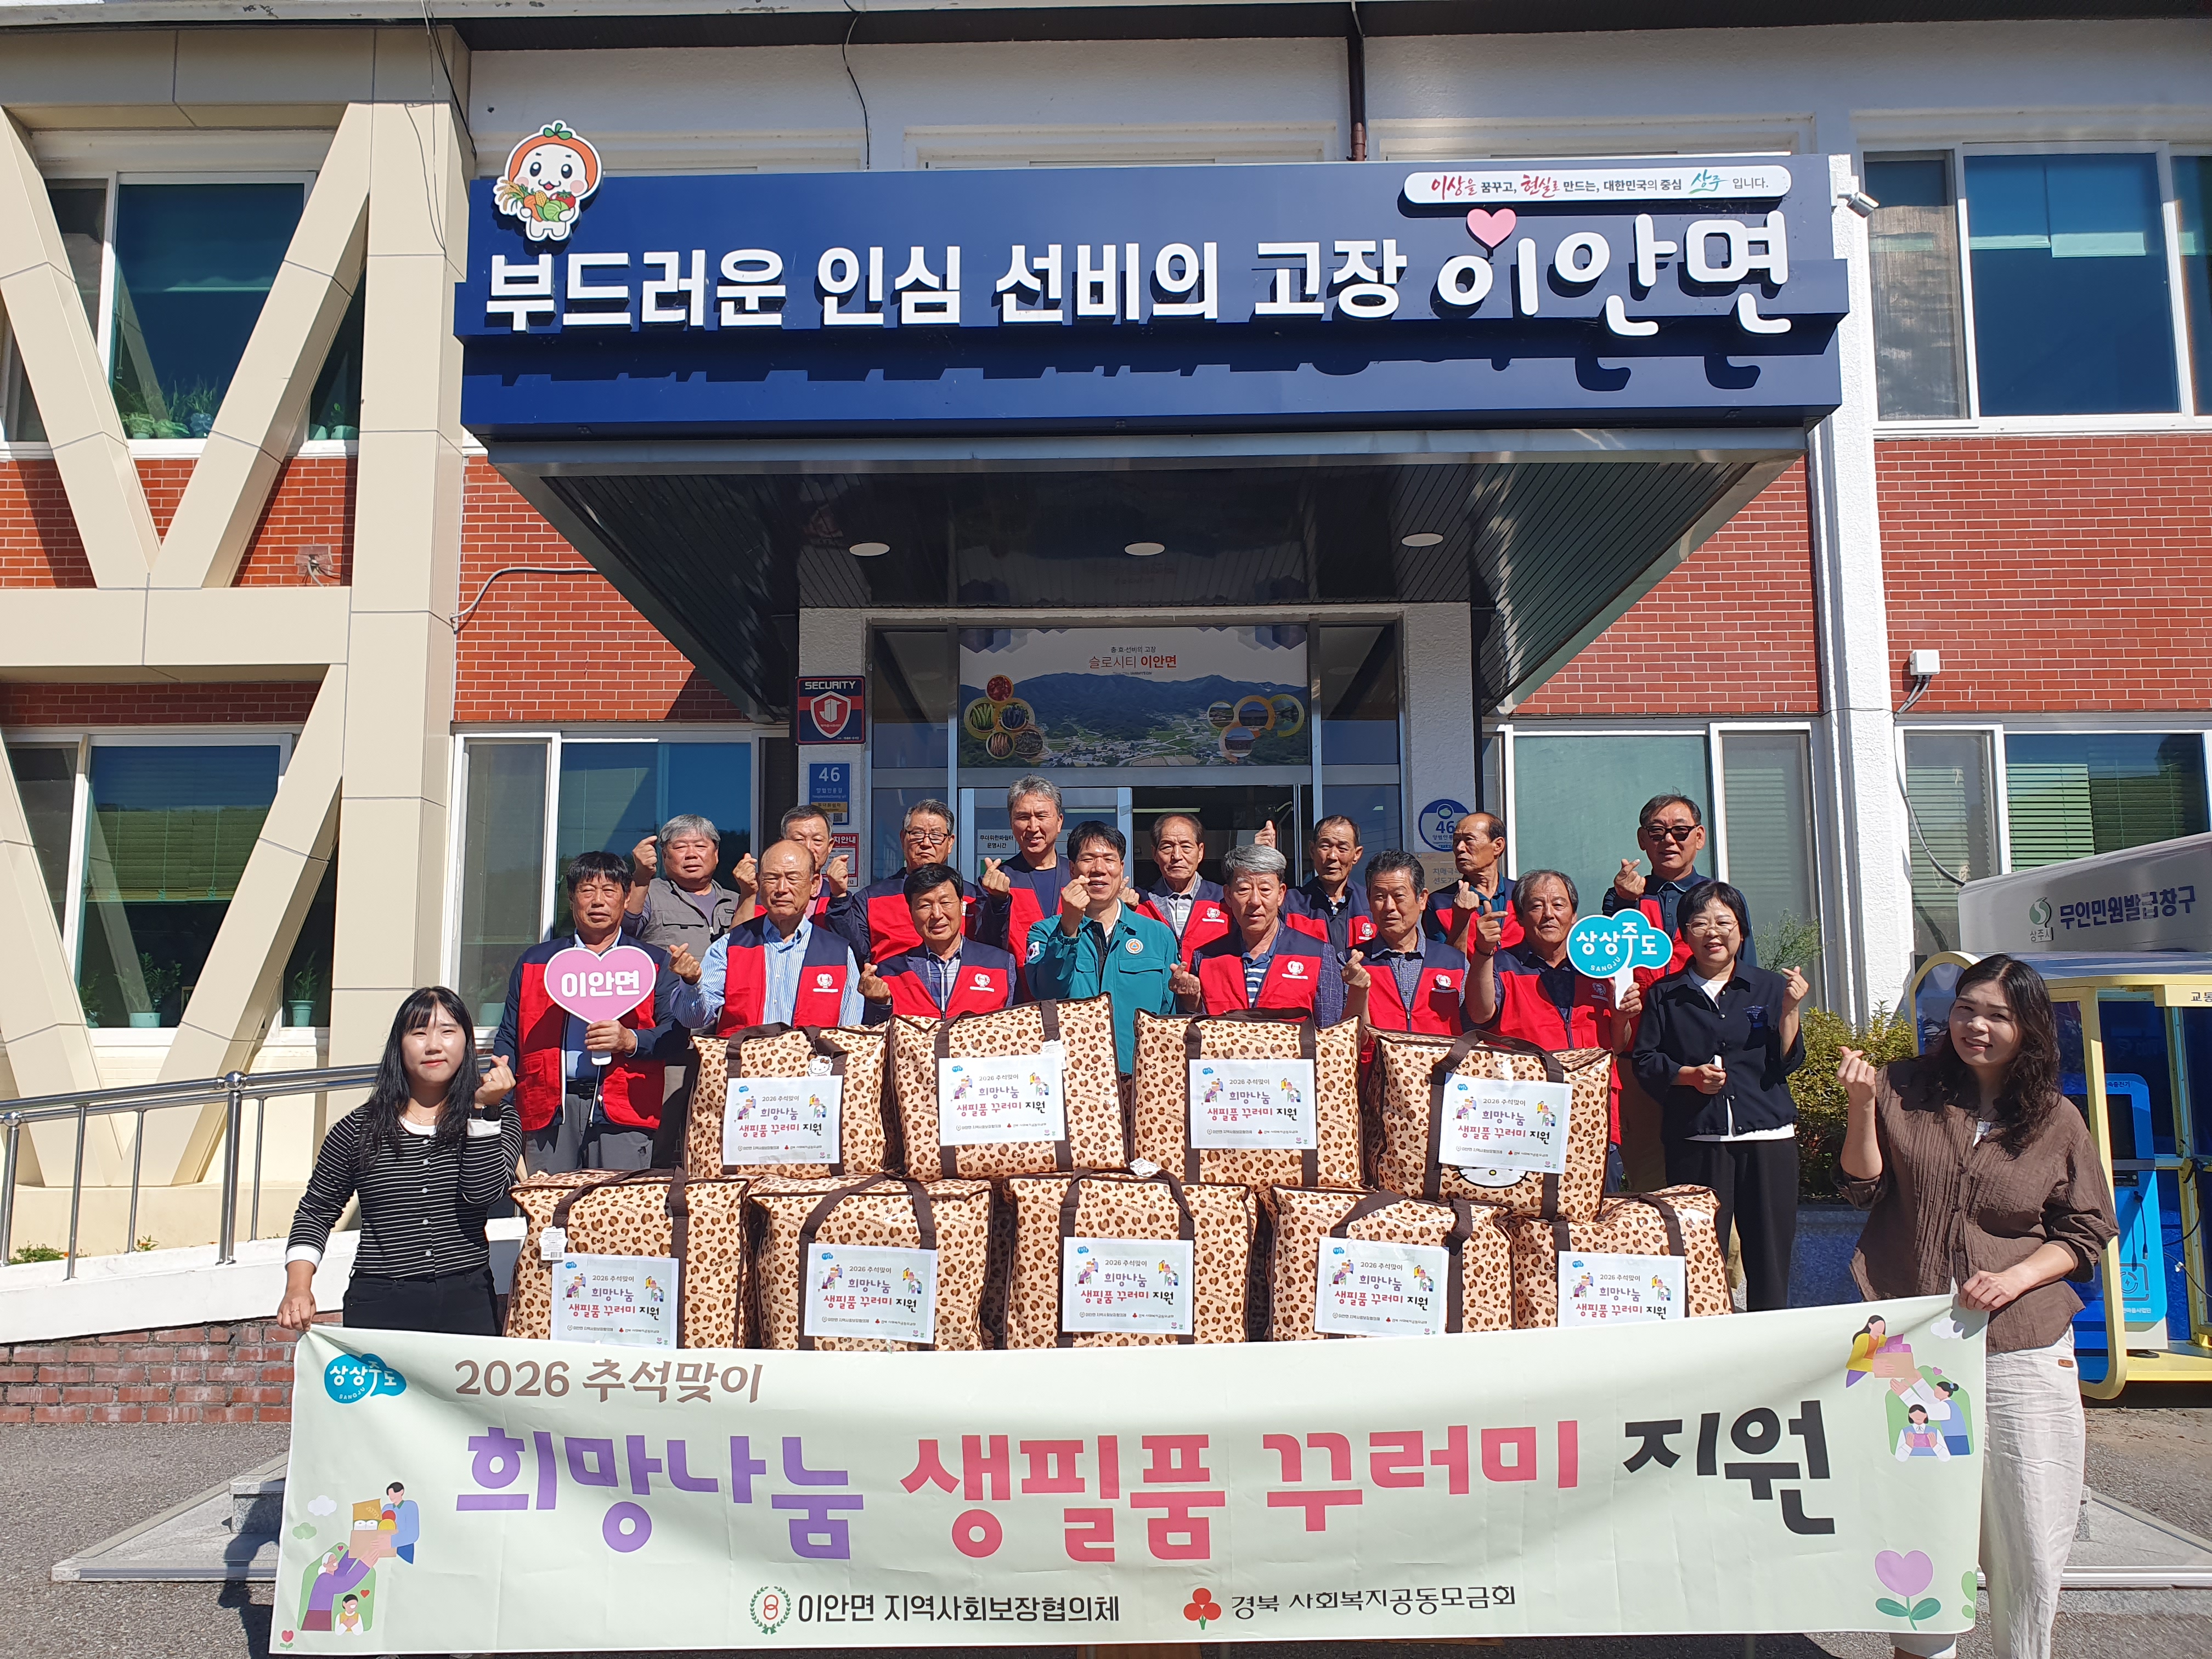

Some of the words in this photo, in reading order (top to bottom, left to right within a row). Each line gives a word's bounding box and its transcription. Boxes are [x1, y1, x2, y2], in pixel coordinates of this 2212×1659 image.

[1431, 176, 1477, 200] 이상을
[1481, 182, 1517, 194] 꿈꾸고,
[1520, 176, 1560, 198] 현실로
[1563, 181, 1599, 193] 만드는,
[1604, 179, 1657, 192] 대한민국의
[1660, 178, 1681, 191] 중심
[1689, 169, 1730, 194] 상주
[1733, 177, 1769, 189] 입니다.
[487, 249, 786, 331] 부드러운
[817, 246, 960, 326] 인심
[996, 243, 1218, 323] 선비의
[1255, 239, 1407, 319] 고장
[1437, 210, 1791, 337] 이안면
[1089, 656, 1136, 669] 슬로시티
[1141, 654, 1177, 669] 이안면
[805, 681, 856, 690] SECURITY
[819, 767, 840, 782] 46
[1435, 821, 1455, 834] 46
[2060, 885, 2196, 929] 무인민원발급창구
[1576, 922, 1657, 956] 상상주도
[1590, 956, 1621, 972] SANGJU
[561, 970, 640, 997] 이안면
[979, 1086, 1019, 1099] 희망나눔
[1229, 1091, 1271, 1105] 희망나눔
[760, 1108, 798, 1120] 희망나눔
[957, 1103, 988, 1116] 생필품
[991, 1102, 1022, 1113] 꾸러미
[1025, 1101, 1045, 1114] 지원
[1207, 1108, 1238, 1121] 생필품
[1242, 1108, 1273, 1119] 꾸러미
[1277, 1108, 1297, 1121] 지원
[1482, 1110, 1525, 1126] 희망나눔
[739, 1125, 768, 1138] 생필품
[771, 1124, 799, 1135] 꾸러미
[803, 1123, 822, 1136] 지원
[1458, 1125, 1491, 1140] 생필품
[1494, 1127, 1526, 1138] 꾸러미
[1530, 1131, 1550, 1144] 지원
[848, 1278, 891, 1294] 희망나눔
[1104, 1273, 1147, 1288] 희망나눔
[1359, 1274, 1402, 1291] 희망나눔
[591, 1288, 634, 1302] 희망나눔
[1081, 1290, 1113, 1305] 생필품
[1116, 1291, 1149, 1301] 꾸러미
[1153, 1291, 1173, 1305] 지원
[1334, 1290, 1367, 1306] 생필품
[1371, 1293, 1403, 1305] 꾸러미
[1407, 1296, 1428, 1311] 지원
[1599, 1287, 1641, 1302] 희망나눔
[823, 1295, 856, 1309] 생필품
[860, 1296, 892, 1307] 꾸러미
[896, 1299, 917, 1313] 지원
[1576, 1303, 1608, 1318] 생필품
[1611, 1305, 1643, 1316] 꾸러미
[1646, 1306, 1666, 1319] 지원
[568, 1304, 600, 1318] 생필품
[603, 1305, 635, 1316] 꾸러미
[639, 1306, 659, 1321] 지원
[454, 1359, 571, 1399] 2026
[582, 1358, 762, 1404] 추석맞이
[339, 1387, 365, 1400] SANGJU
[456, 1426, 865, 1560] 희망나눔
[901, 1434, 1226, 1561] 생필품
[1262, 1419, 1579, 1533] 꾸러미
[1622, 1399, 1836, 1536] 지원
[798, 1594, 874, 1622] 이안면
[884, 1594, 1120, 1622] 지역사회보장협의체
[1232, 1594, 1280, 1620] 경북
[1288, 1584, 1516, 1615] 사회복지공동모금회
